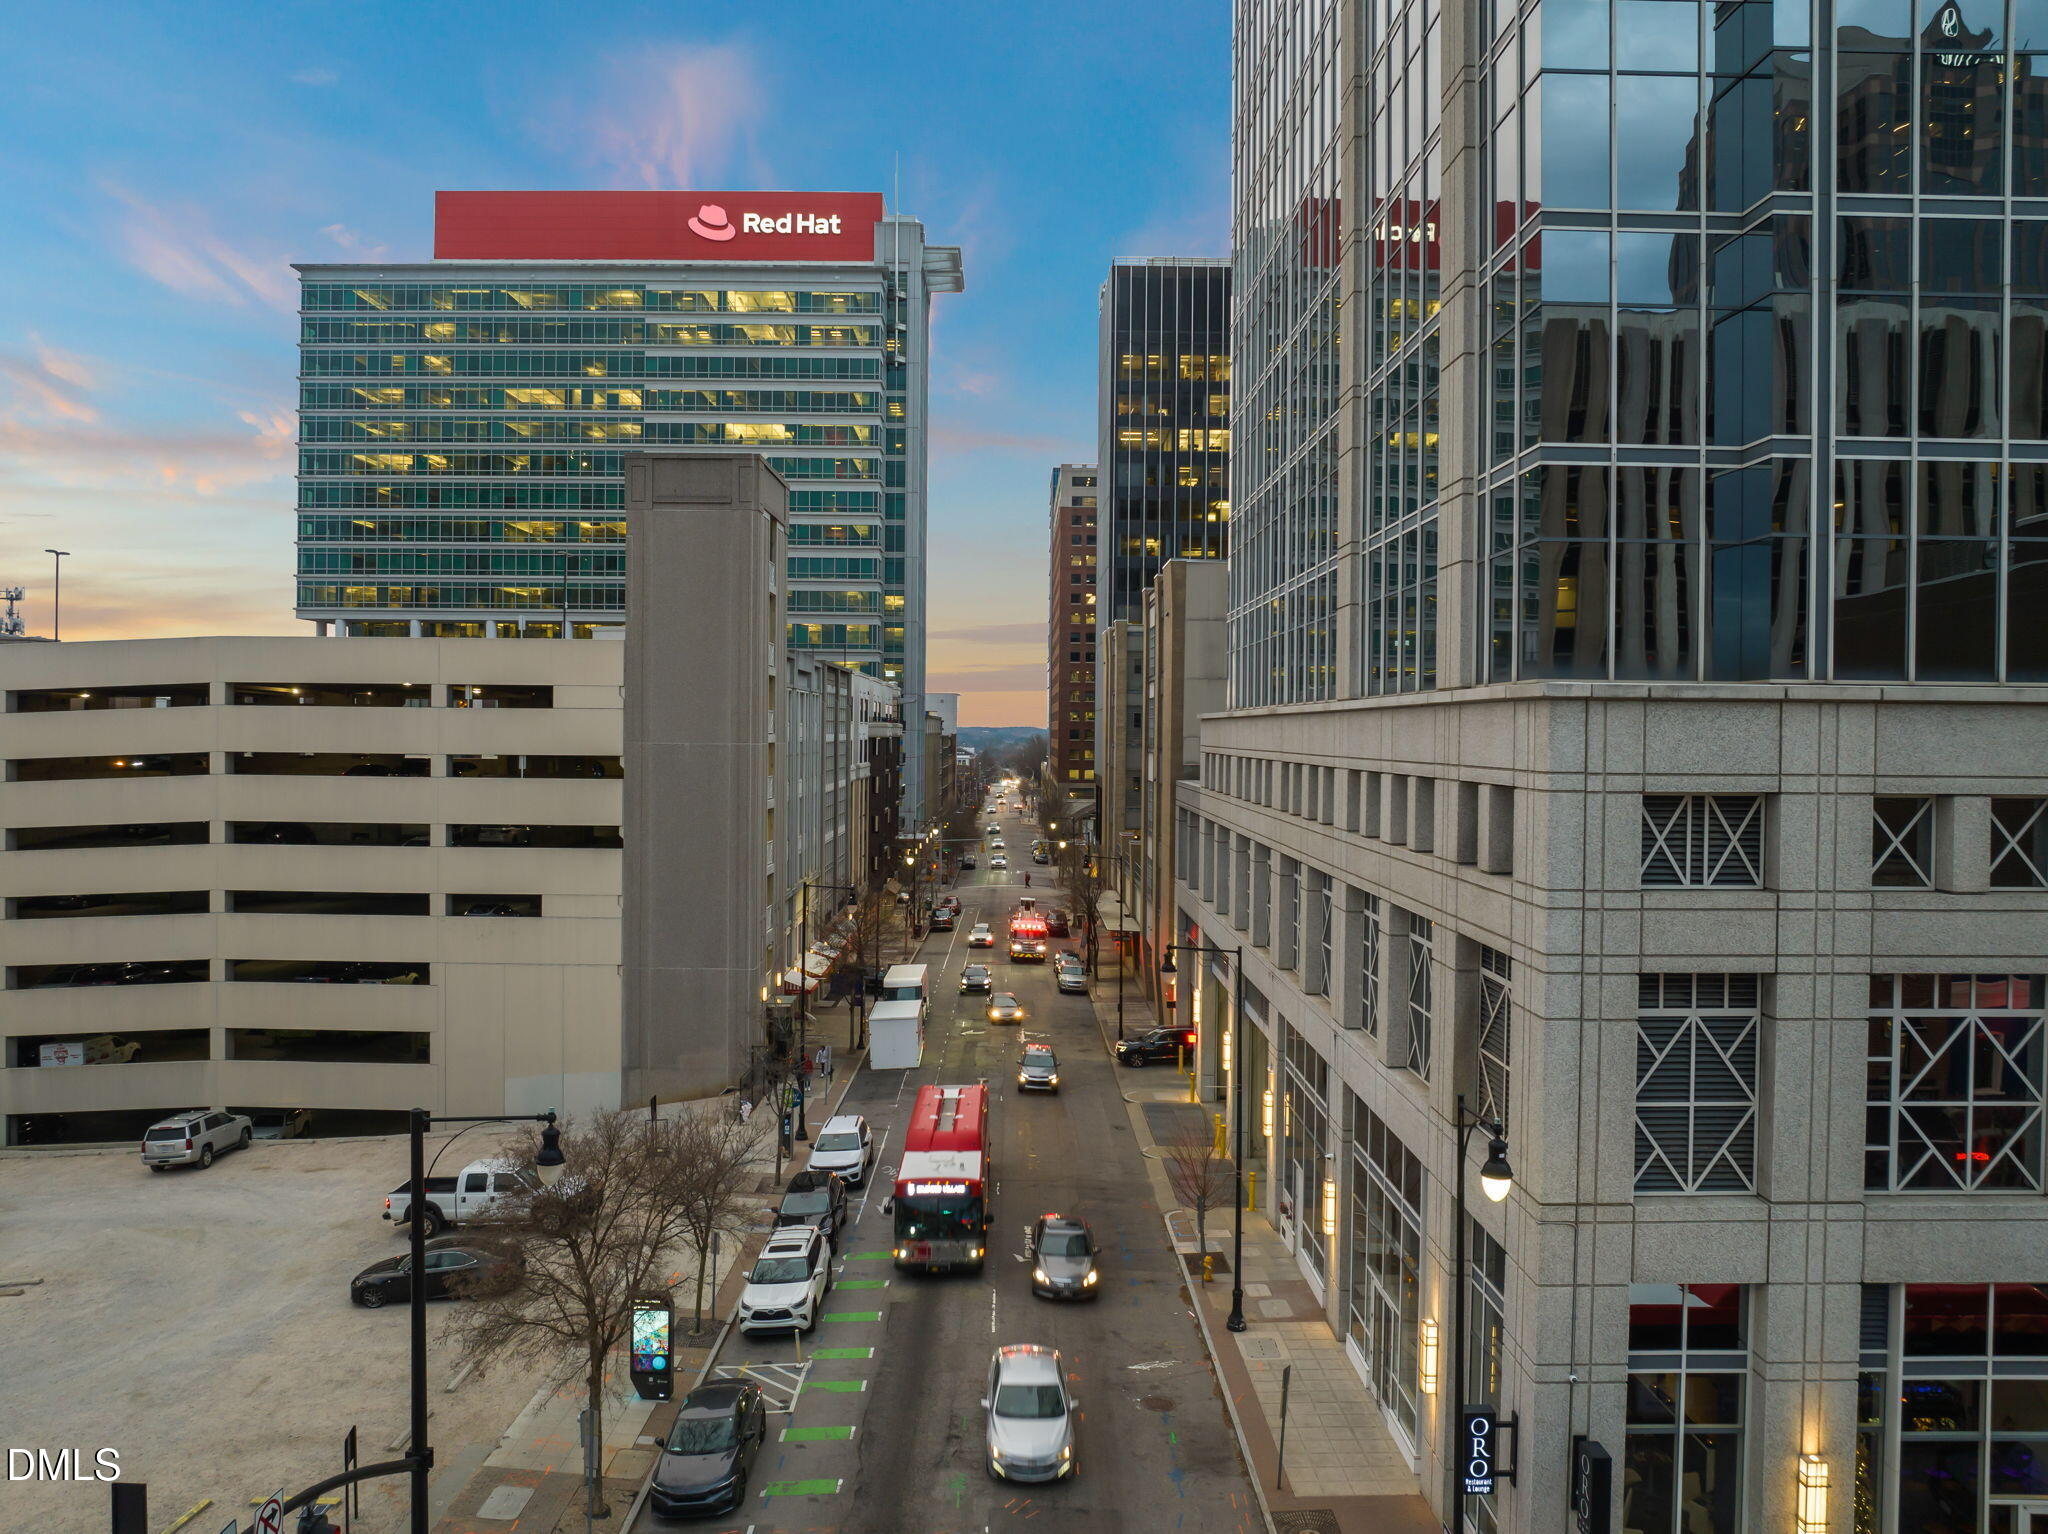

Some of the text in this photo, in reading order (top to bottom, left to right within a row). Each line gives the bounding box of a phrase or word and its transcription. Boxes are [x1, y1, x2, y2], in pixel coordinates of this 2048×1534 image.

[743, 213, 841, 234] Red Hat
[1470, 1417, 1491, 1477] ORO
[1472, 1486, 1490, 1494] Lounge
[1581, 1454, 1589, 1518] ORO
